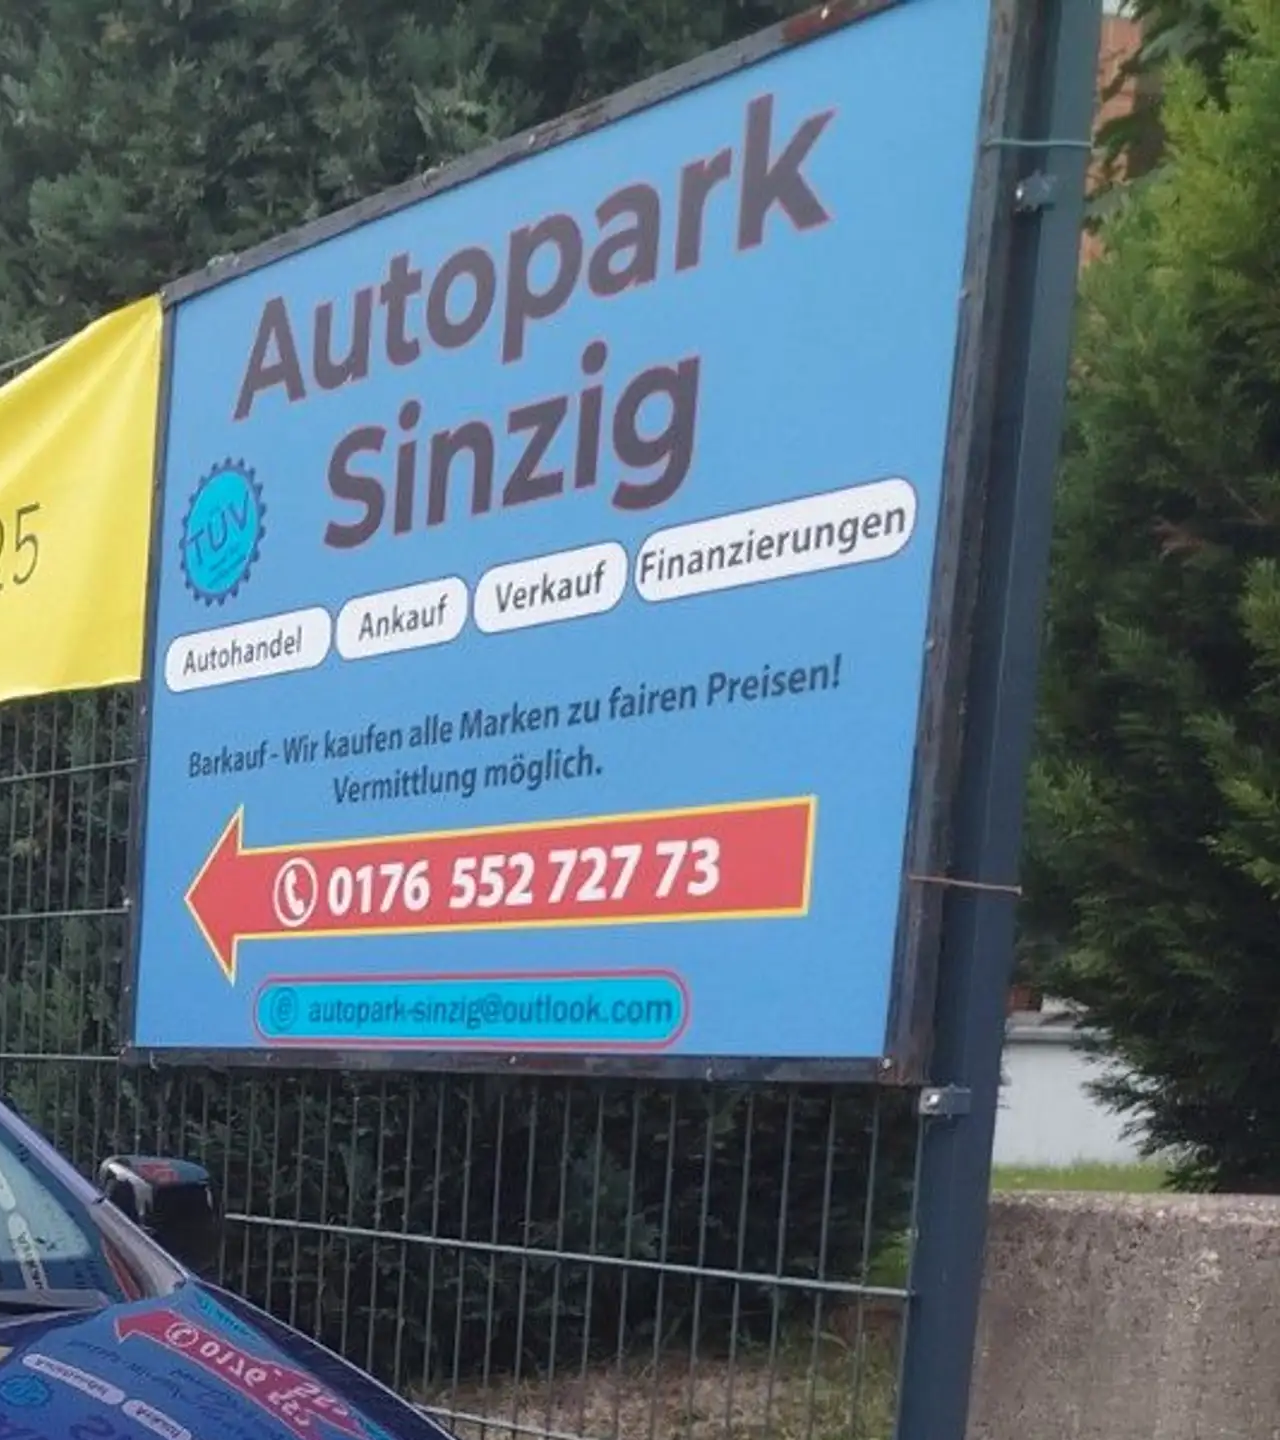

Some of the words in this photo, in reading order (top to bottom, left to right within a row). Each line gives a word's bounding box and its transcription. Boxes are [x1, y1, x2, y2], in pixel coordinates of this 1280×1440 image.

[232, 94, 835, 422] Autopark
[323, 341, 701, 549] Sinzig
[639, 506, 906, 584] Finanzierungen
[358, 593, 448, 641] Ankauf
[496, 560, 607, 613] Verkauf
[183, 626, 302, 676] Autohandel
[188, 741, 269, 778] Barkauf
[283, 734, 318, 765] Wir
[324, 724, 404, 760] kaufen
[409, 714, 453, 748] alle
[459, 702, 560, 741] Marken
[567, 698, 601, 726] zu
[608, 684, 697, 720] fairen
[706, 654, 842, 706] Preisen!
[332, 764, 478, 805] Vermittlung
[484, 744, 604, 791] möglich.
[326, 859, 432, 916] 0176
[448, 851, 535, 909] 552
[546, 843, 642, 904] 727
[653, 836, 721, 898] 73
[308, 990, 673, 1030] autopark-sinzig@outlook.com
